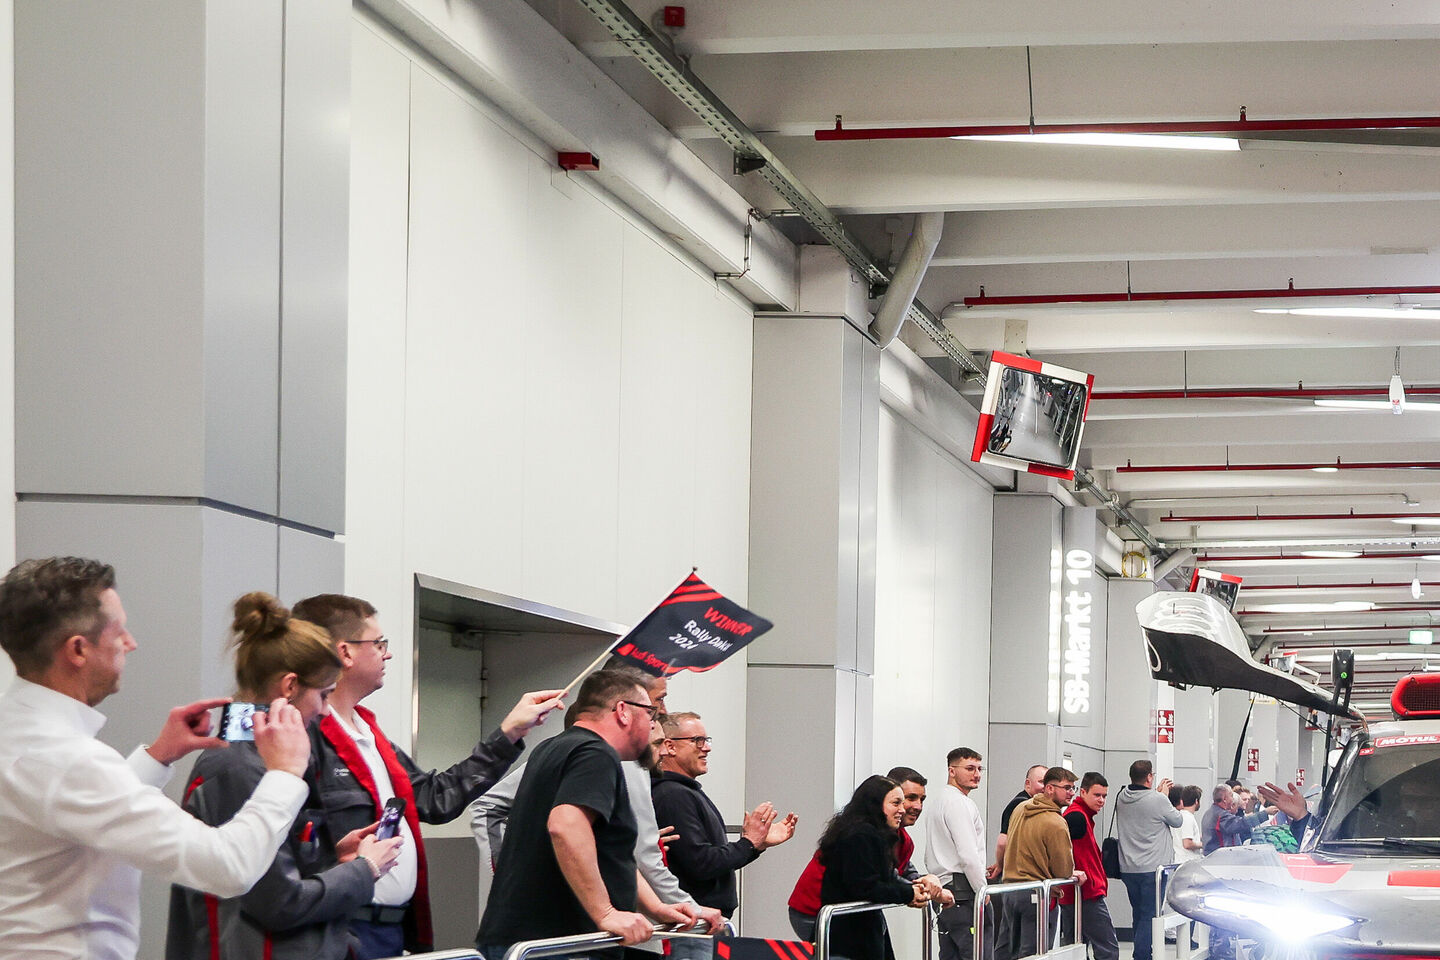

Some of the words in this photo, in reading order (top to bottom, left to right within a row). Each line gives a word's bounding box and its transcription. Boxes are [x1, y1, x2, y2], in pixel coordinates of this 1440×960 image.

[1066, 549, 1092, 585] 10
[684, 619, 711, 643] Rally
[704, 607, 753, 637] WINNER
[1064, 590, 1092, 714] SB-Markt
[1380, 735, 1439, 746] MOTUL
